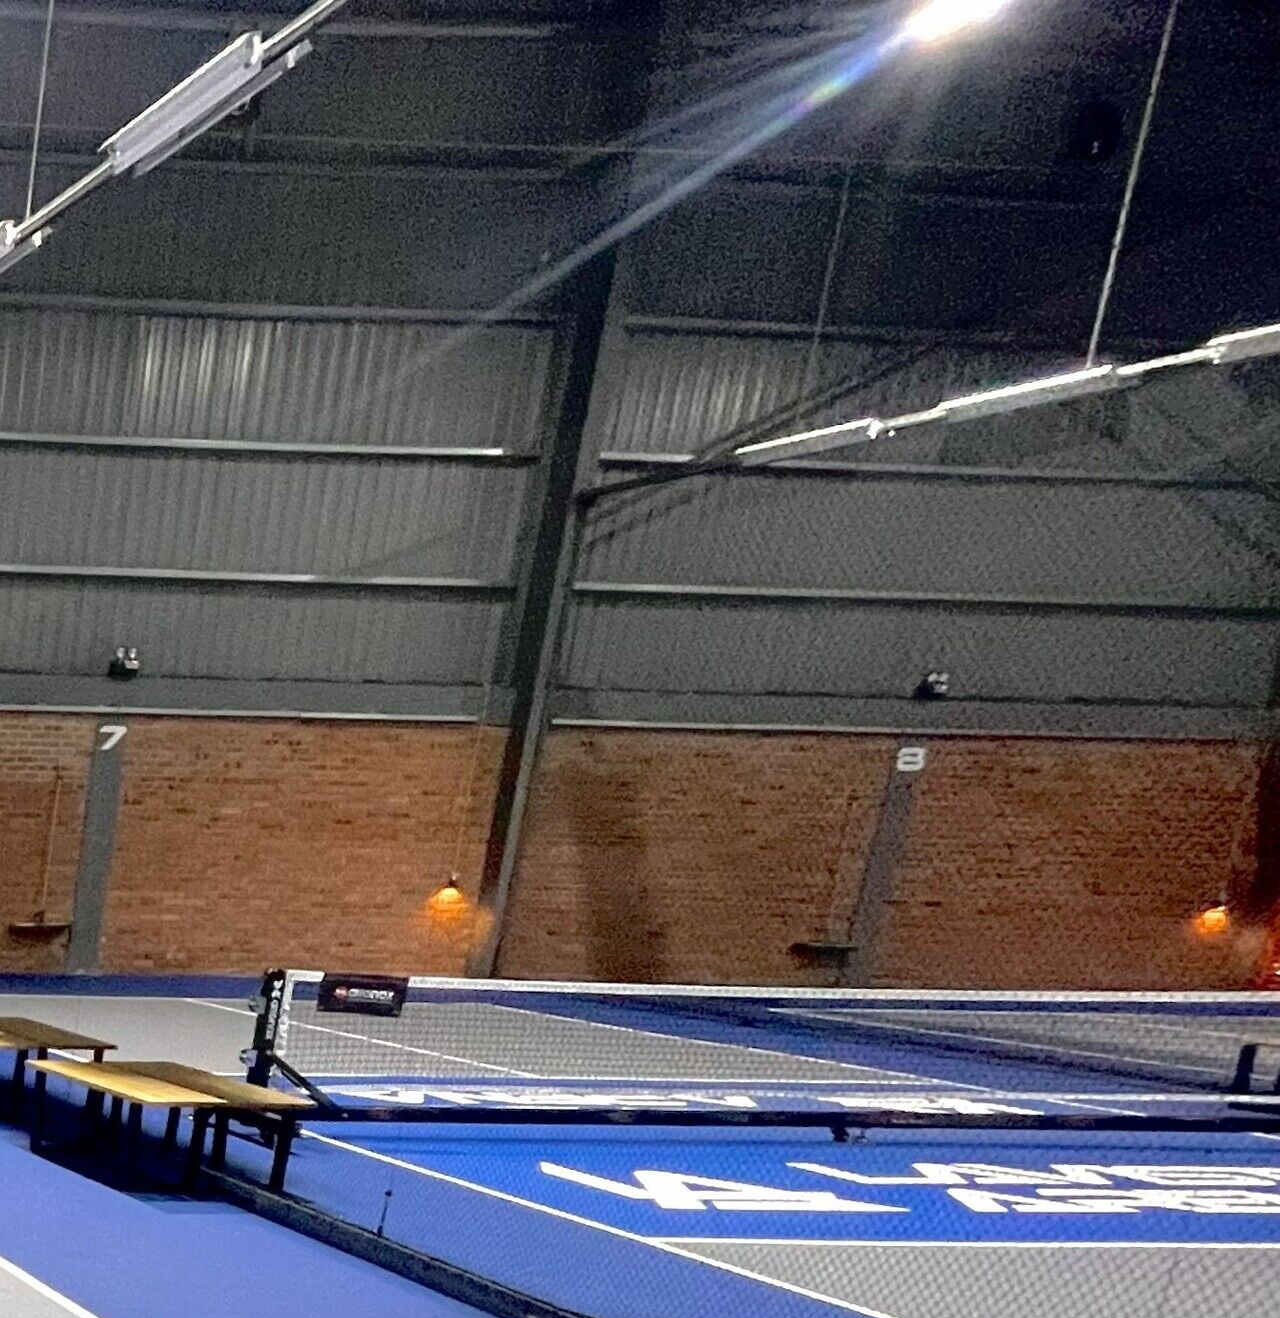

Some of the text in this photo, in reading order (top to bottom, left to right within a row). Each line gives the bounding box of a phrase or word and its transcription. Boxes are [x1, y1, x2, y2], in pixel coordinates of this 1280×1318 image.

[100, 725, 127, 750] 7
[897, 747, 926, 772] 8
[786, 1162, 1280, 1186] LAVIS
